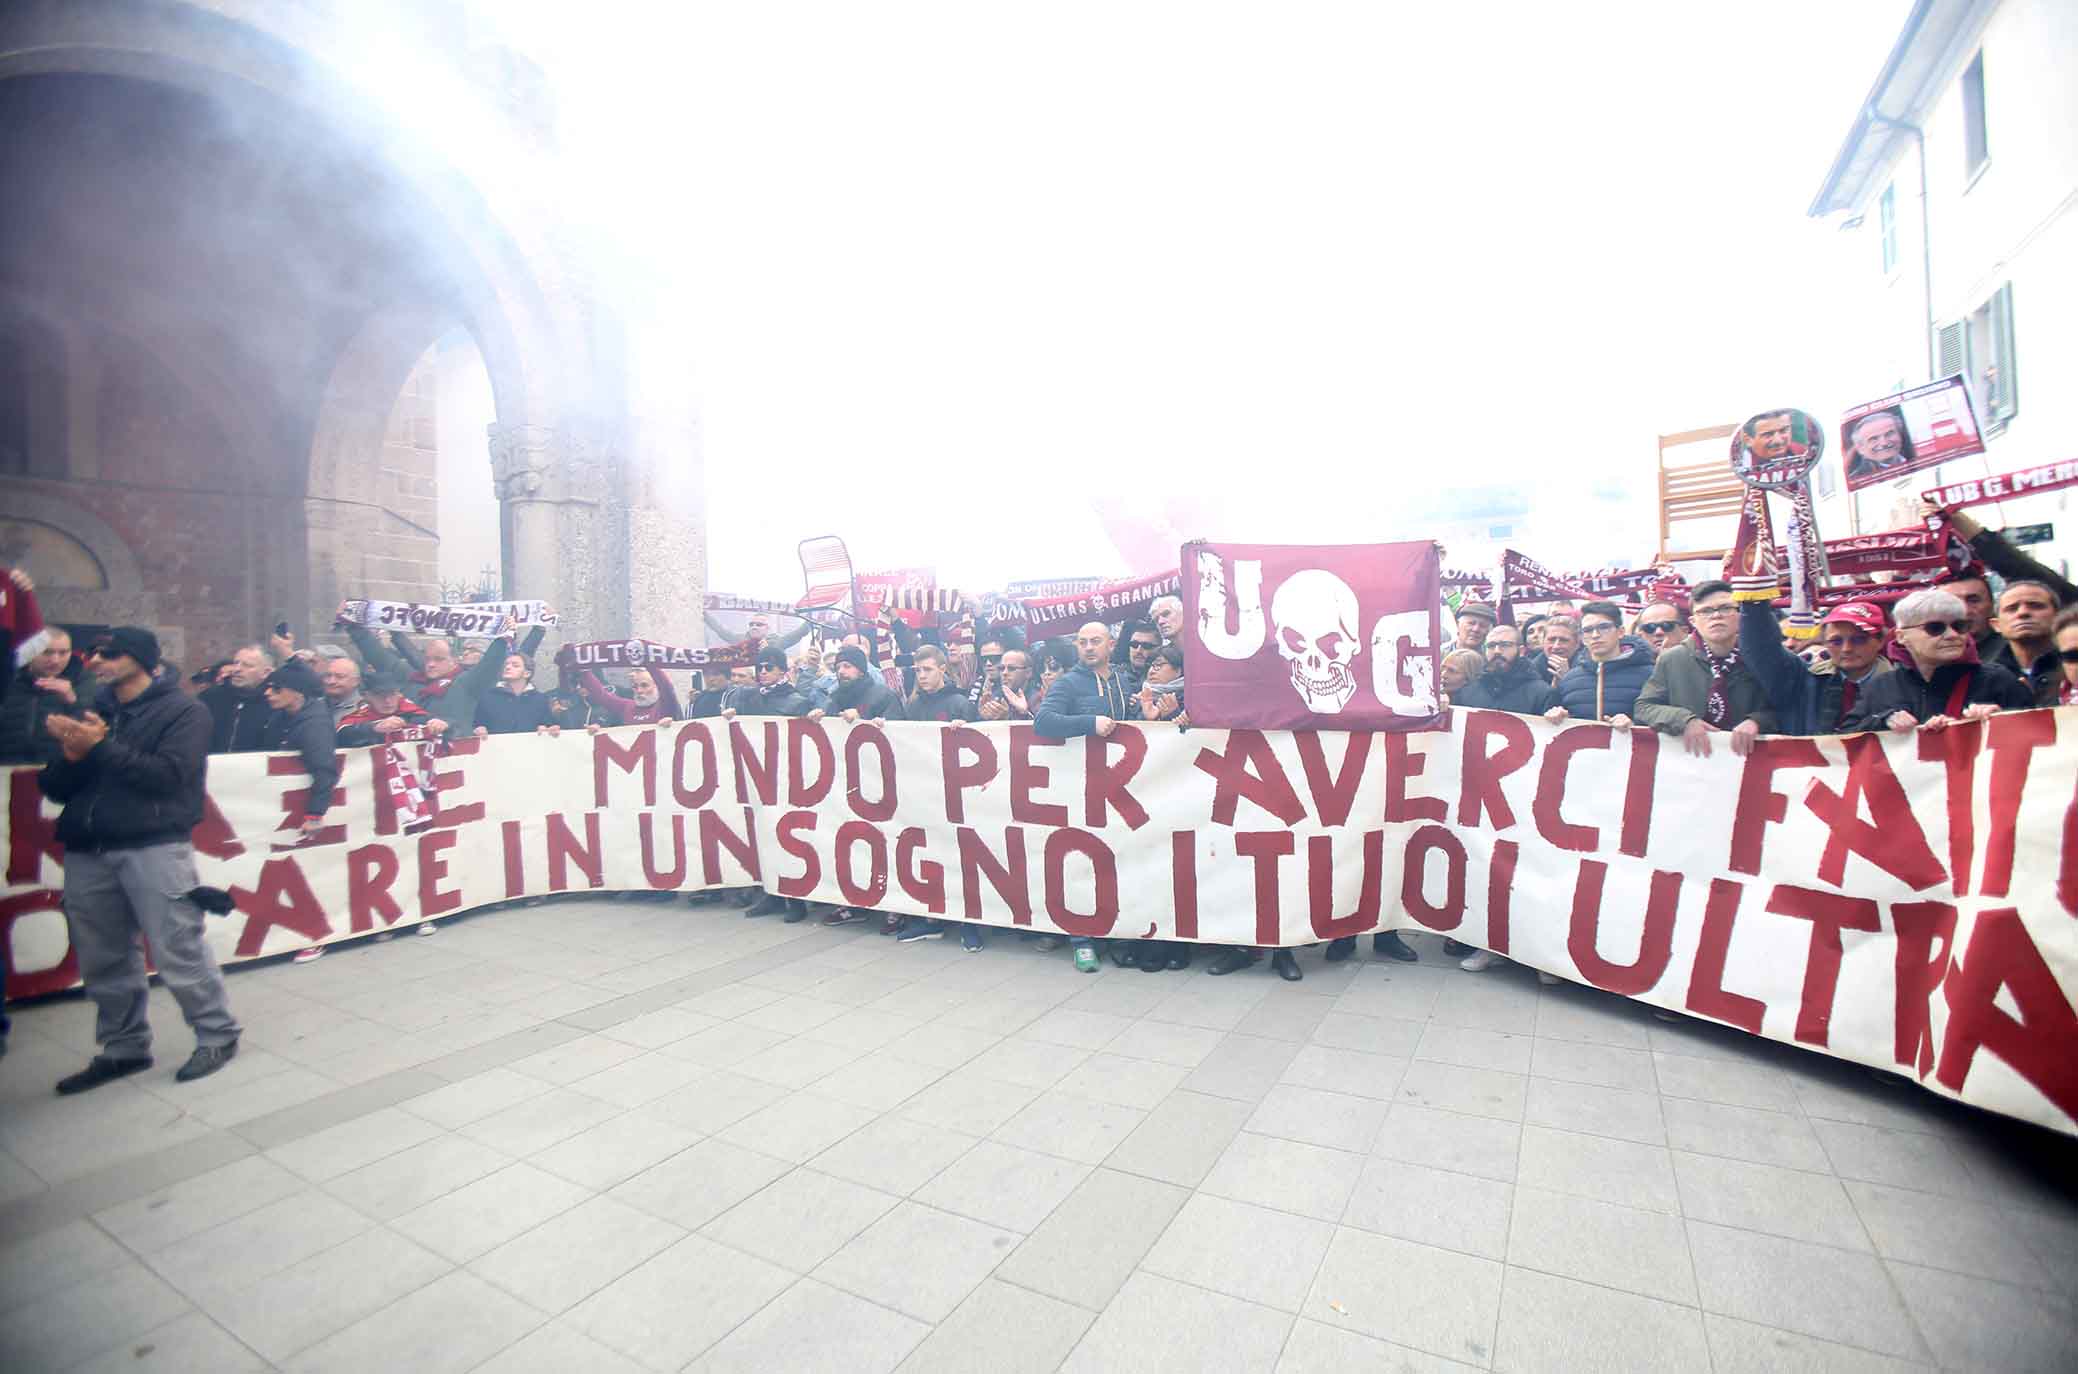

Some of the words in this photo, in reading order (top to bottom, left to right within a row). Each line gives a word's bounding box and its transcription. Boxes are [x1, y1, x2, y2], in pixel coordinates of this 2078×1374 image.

[1030, 600, 1089, 625] ULTRAS
[1110, 576, 1182, 609] GRANATA
[1197, 550, 1266, 660] U
[1371, 610, 1439, 717] G
[503, 812, 602, 896] IN
[640, 806, 762, 889] UN
[1172, 830, 1198, 940] I
[1236, 826, 1519, 953] TUOI
[594, 719, 897, 821] MONDO
[940, 722, 1150, 831] PER
[1194, 710, 1660, 857] AVERCI
[1728, 706, 2078, 920] FATT
